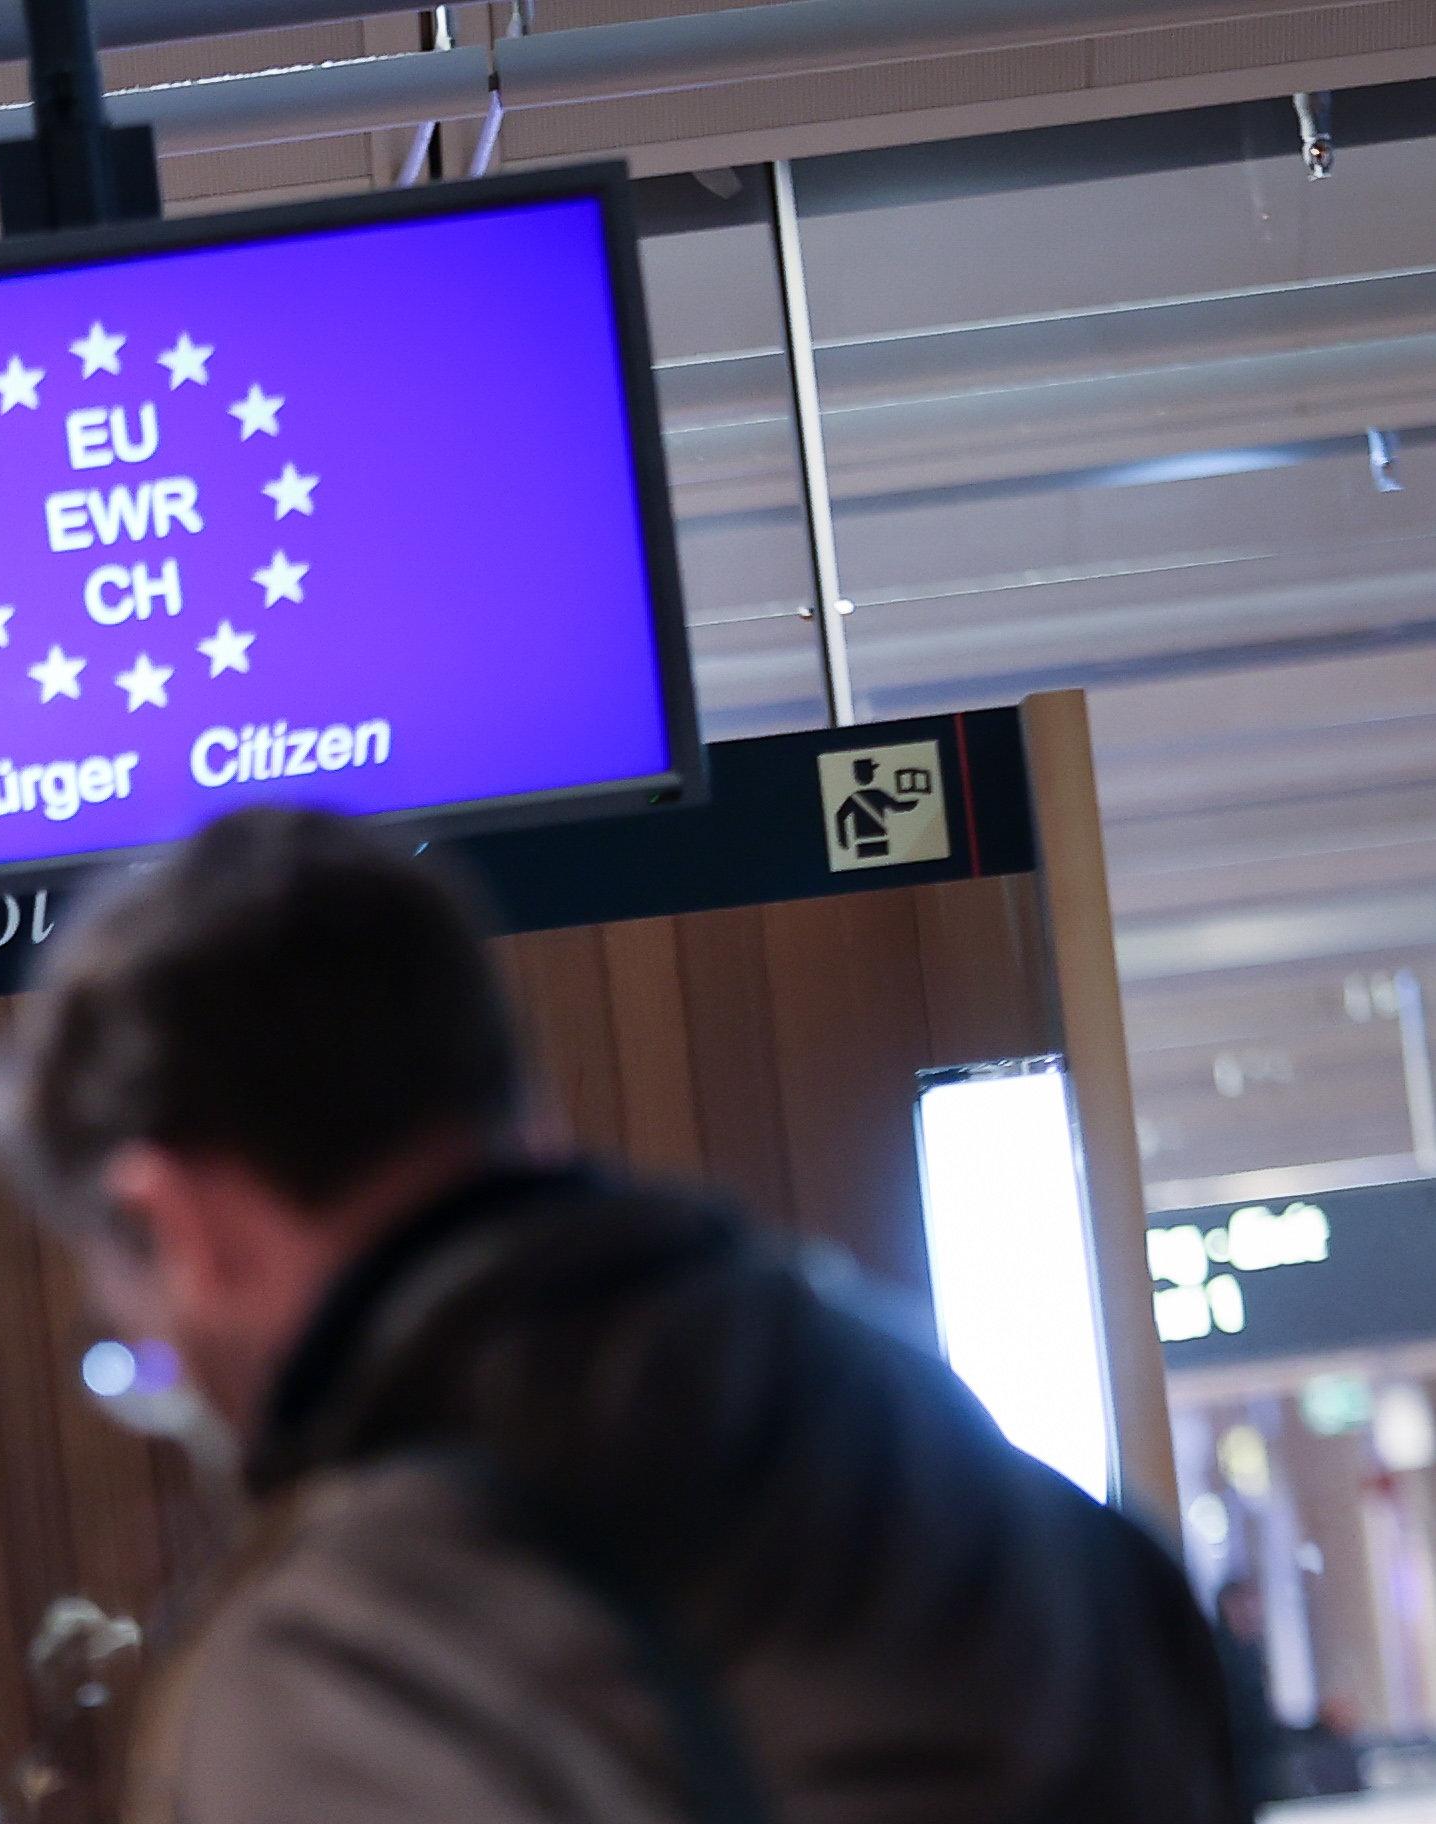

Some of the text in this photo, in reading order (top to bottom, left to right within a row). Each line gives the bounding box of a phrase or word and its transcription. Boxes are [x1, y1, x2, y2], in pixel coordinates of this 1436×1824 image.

[65, 403, 160, 470] EU
[44, 477, 204, 552] EWR
[84, 558, 182, 625] CH
[190, 719, 392, 788] Citizen
